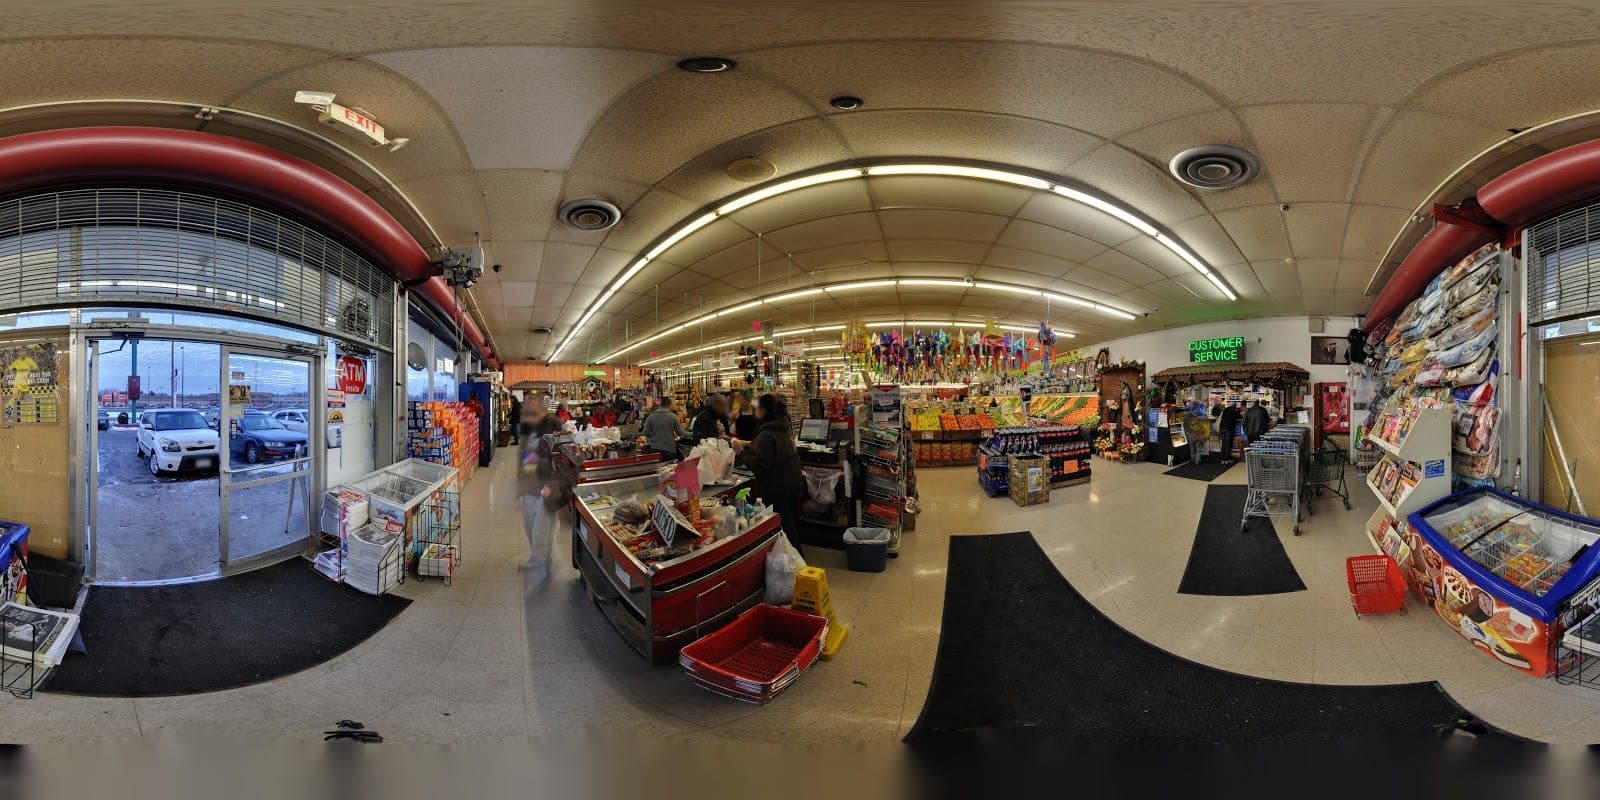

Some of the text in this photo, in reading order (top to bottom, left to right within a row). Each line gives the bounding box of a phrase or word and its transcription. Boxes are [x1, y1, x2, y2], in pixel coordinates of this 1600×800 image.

[344, 108, 378, 134] EXIT
[1188, 338, 1243, 351] CUSTOMER
[1194, 350, 1238, 363] SERVICE
[341, 361, 364, 382] ATM
[345, 383, 360, 393] inside
